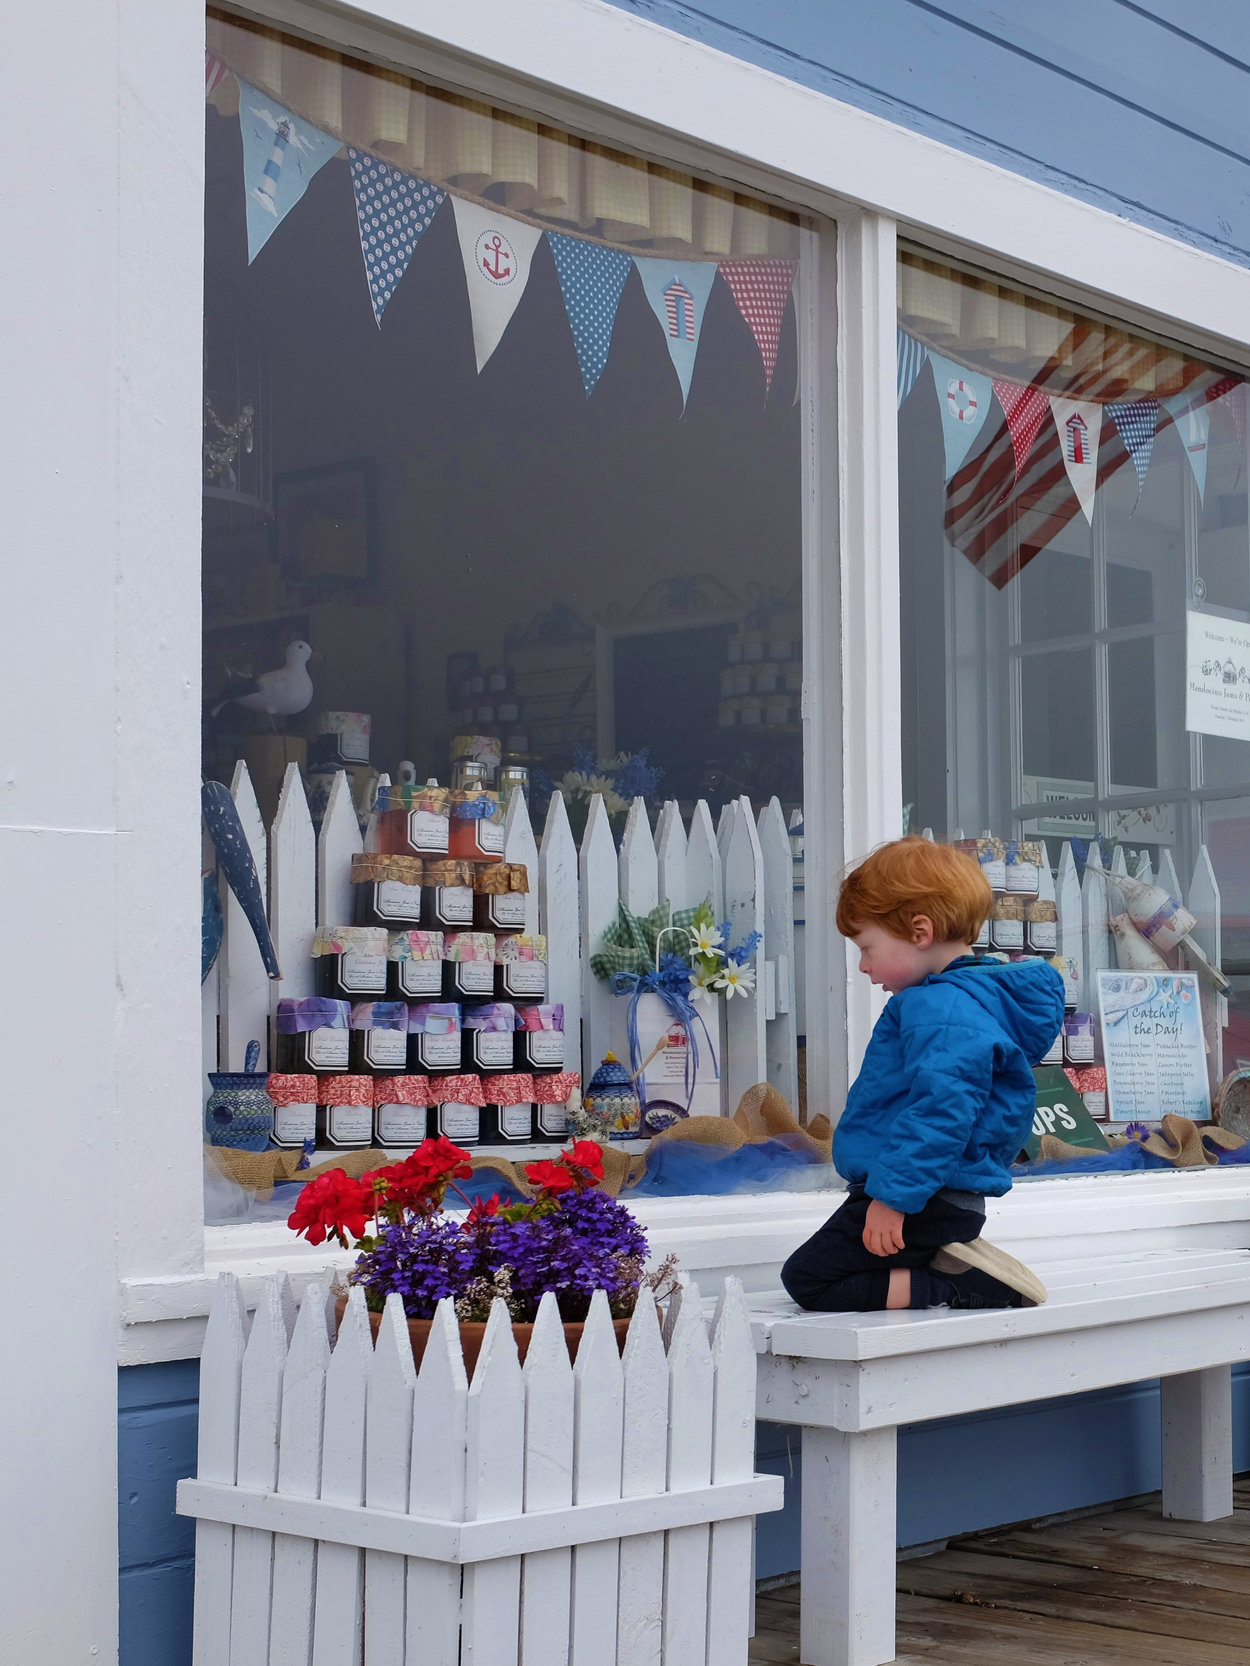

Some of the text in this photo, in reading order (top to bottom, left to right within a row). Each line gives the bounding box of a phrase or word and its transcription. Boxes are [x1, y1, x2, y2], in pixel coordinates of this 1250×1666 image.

[1189, 681, 1222, 697] Mendocino
[1223, 687, 1238, 700] Jams
[1238, 691, 1244, 700] &
[1132, 1005, 1180, 1025] Catch of
[1133, 1021, 1183, 1042] the Day!
